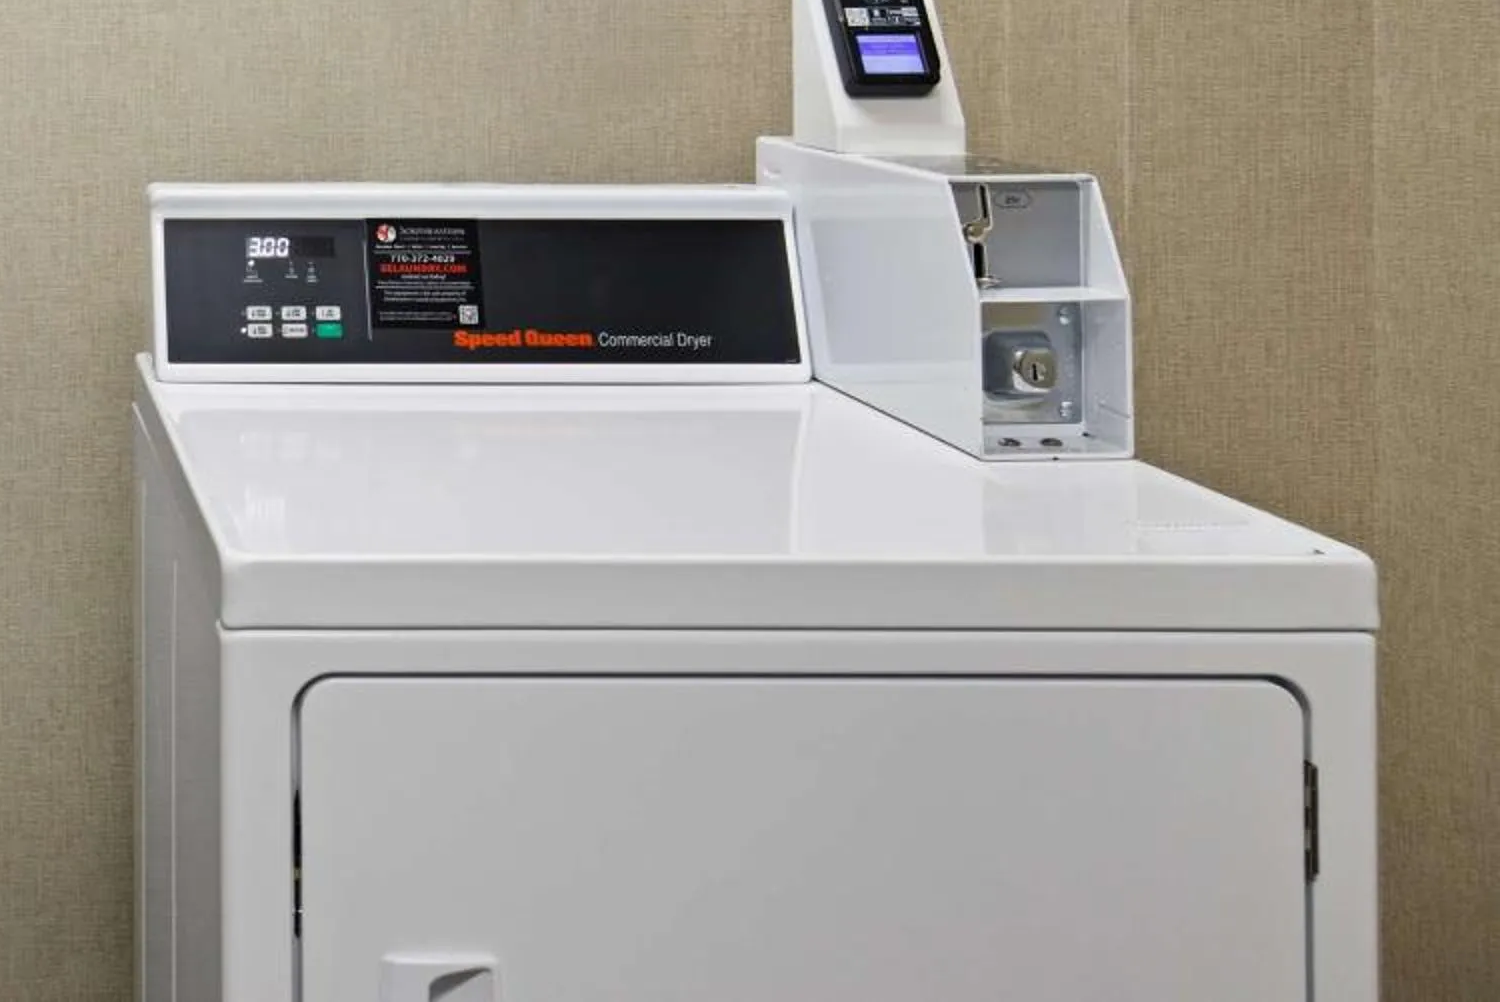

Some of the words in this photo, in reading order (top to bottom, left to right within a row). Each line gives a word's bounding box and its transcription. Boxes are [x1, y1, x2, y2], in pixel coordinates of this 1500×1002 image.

[454, 330, 521, 349] Speed
[525, 330, 593, 347] Queen
[598, 331, 674, 347] Commercial
[676, 331, 712, 350] Dryer
